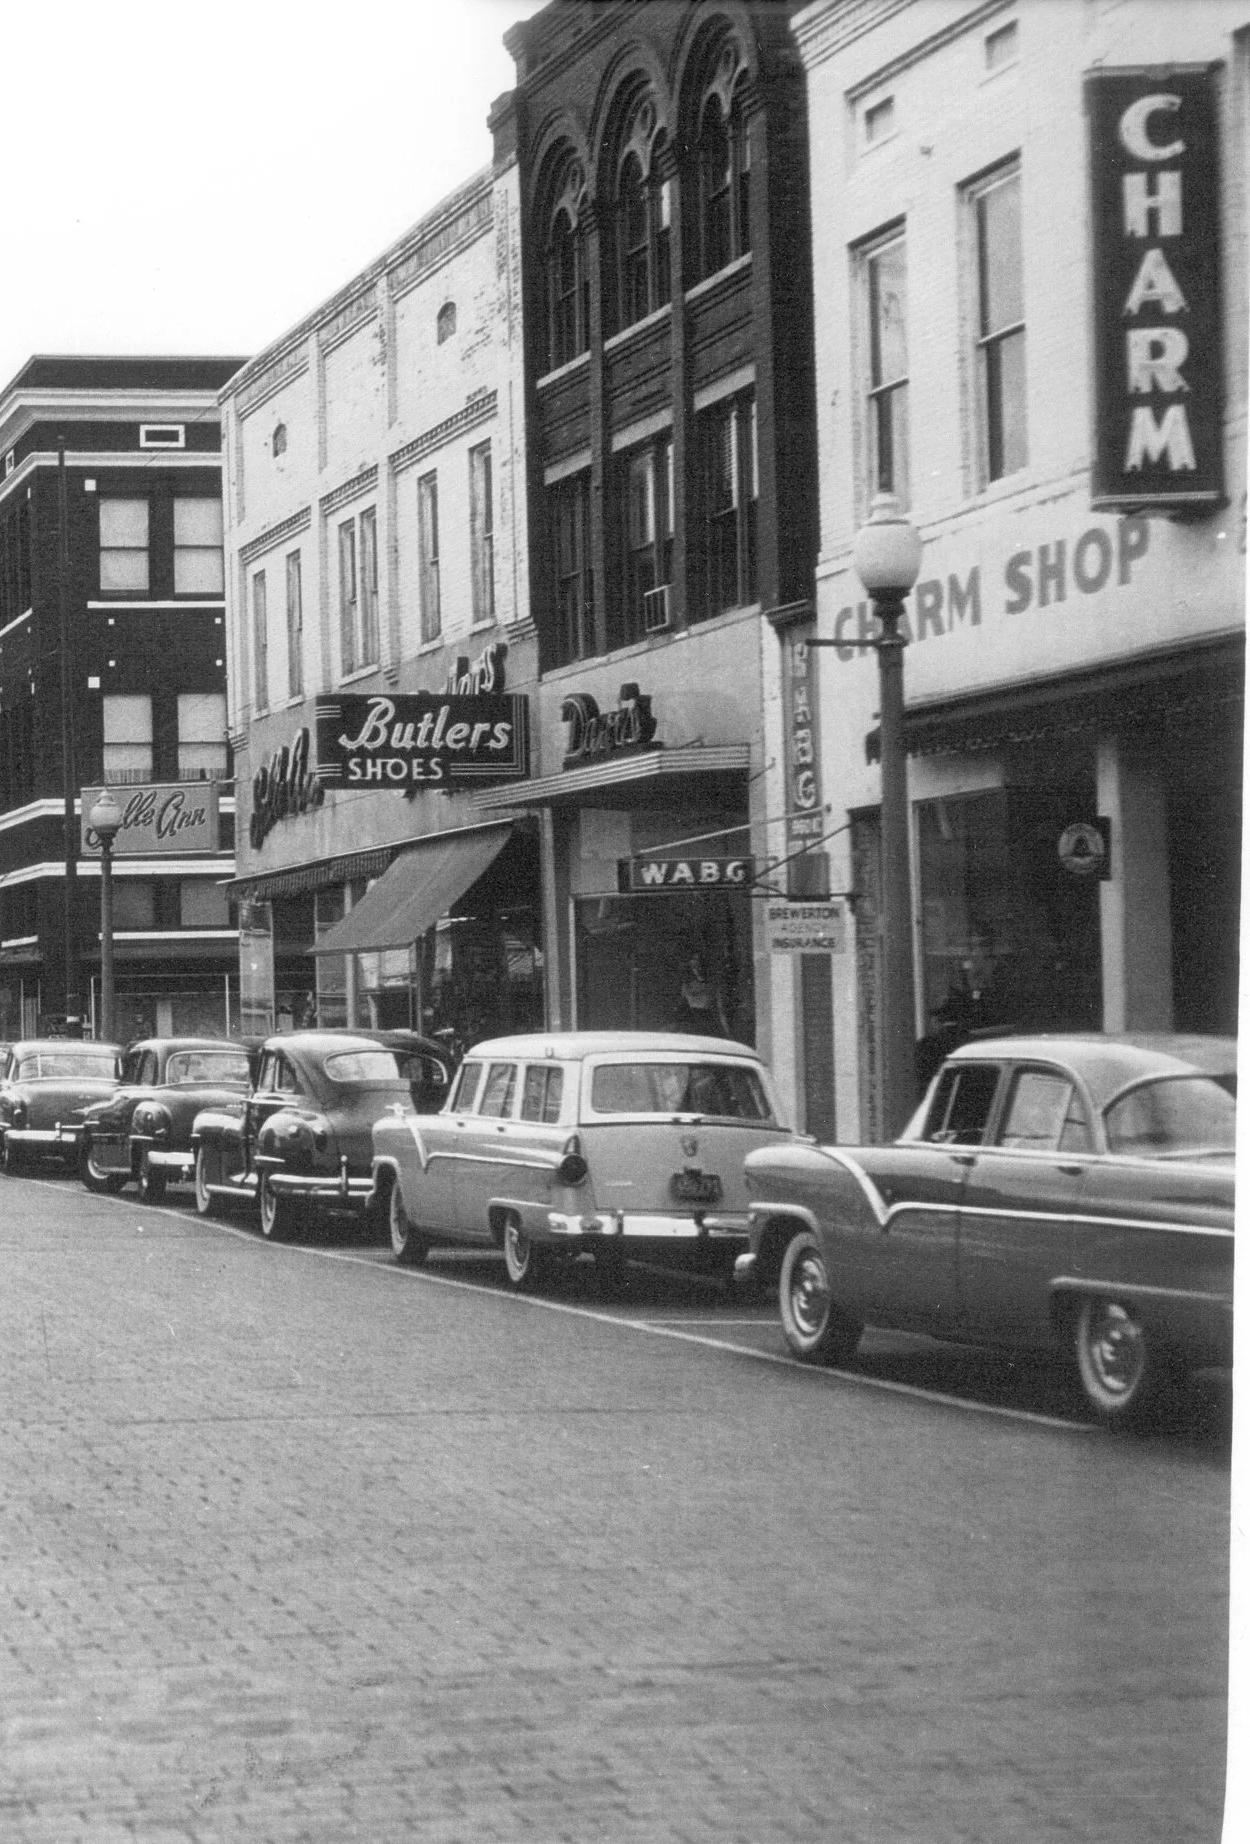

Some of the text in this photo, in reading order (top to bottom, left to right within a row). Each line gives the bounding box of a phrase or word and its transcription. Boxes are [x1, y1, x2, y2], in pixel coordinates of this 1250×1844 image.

[1120, 93, 1196, 472] CHARM
[1005, 515, 1148, 615] SHOP
[338, 696, 513, 751] Butlers
[348, 758, 443, 780] SHOES
[157, 791, 206, 839] Ann
[641, 861, 745, 884] WABG
